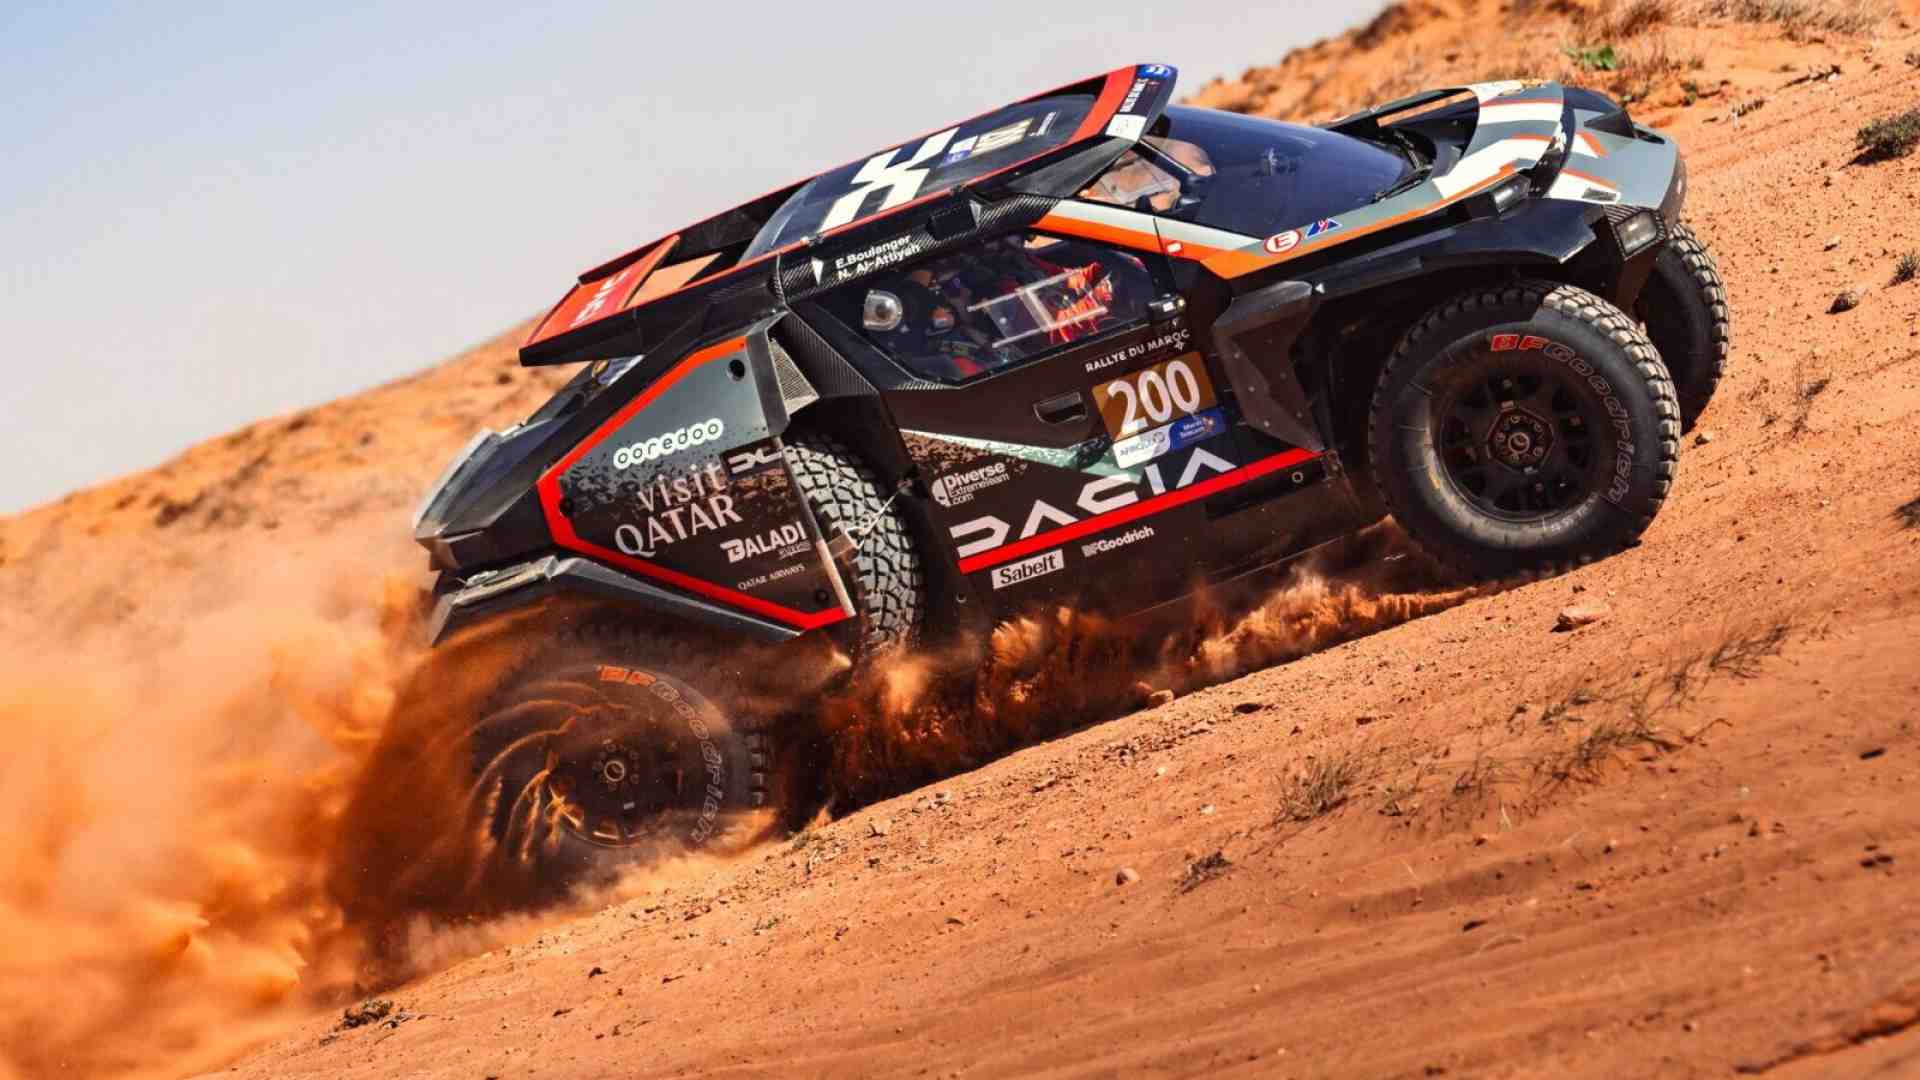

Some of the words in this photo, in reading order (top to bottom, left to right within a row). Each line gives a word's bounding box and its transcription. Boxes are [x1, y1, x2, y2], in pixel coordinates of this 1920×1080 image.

[1085, 350, 1127, 373] RALLYE
[1129, 343, 1146, 358] DU
[1148, 328, 1191, 348] MAROC
[1107, 360, 1201, 434] 200
[617, 422, 720, 465] ooredoo
[637, 463, 727, 512] visit
[943, 462, 1006, 488] Diverse
[614, 494, 744, 558] QATAR
[720, 521, 807, 563] BALADI
[1081, 526, 1155, 558] BFGoodrich
[737, 575, 768, 591] QATAR
[1000, 554, 1057, 584] Sabelt
